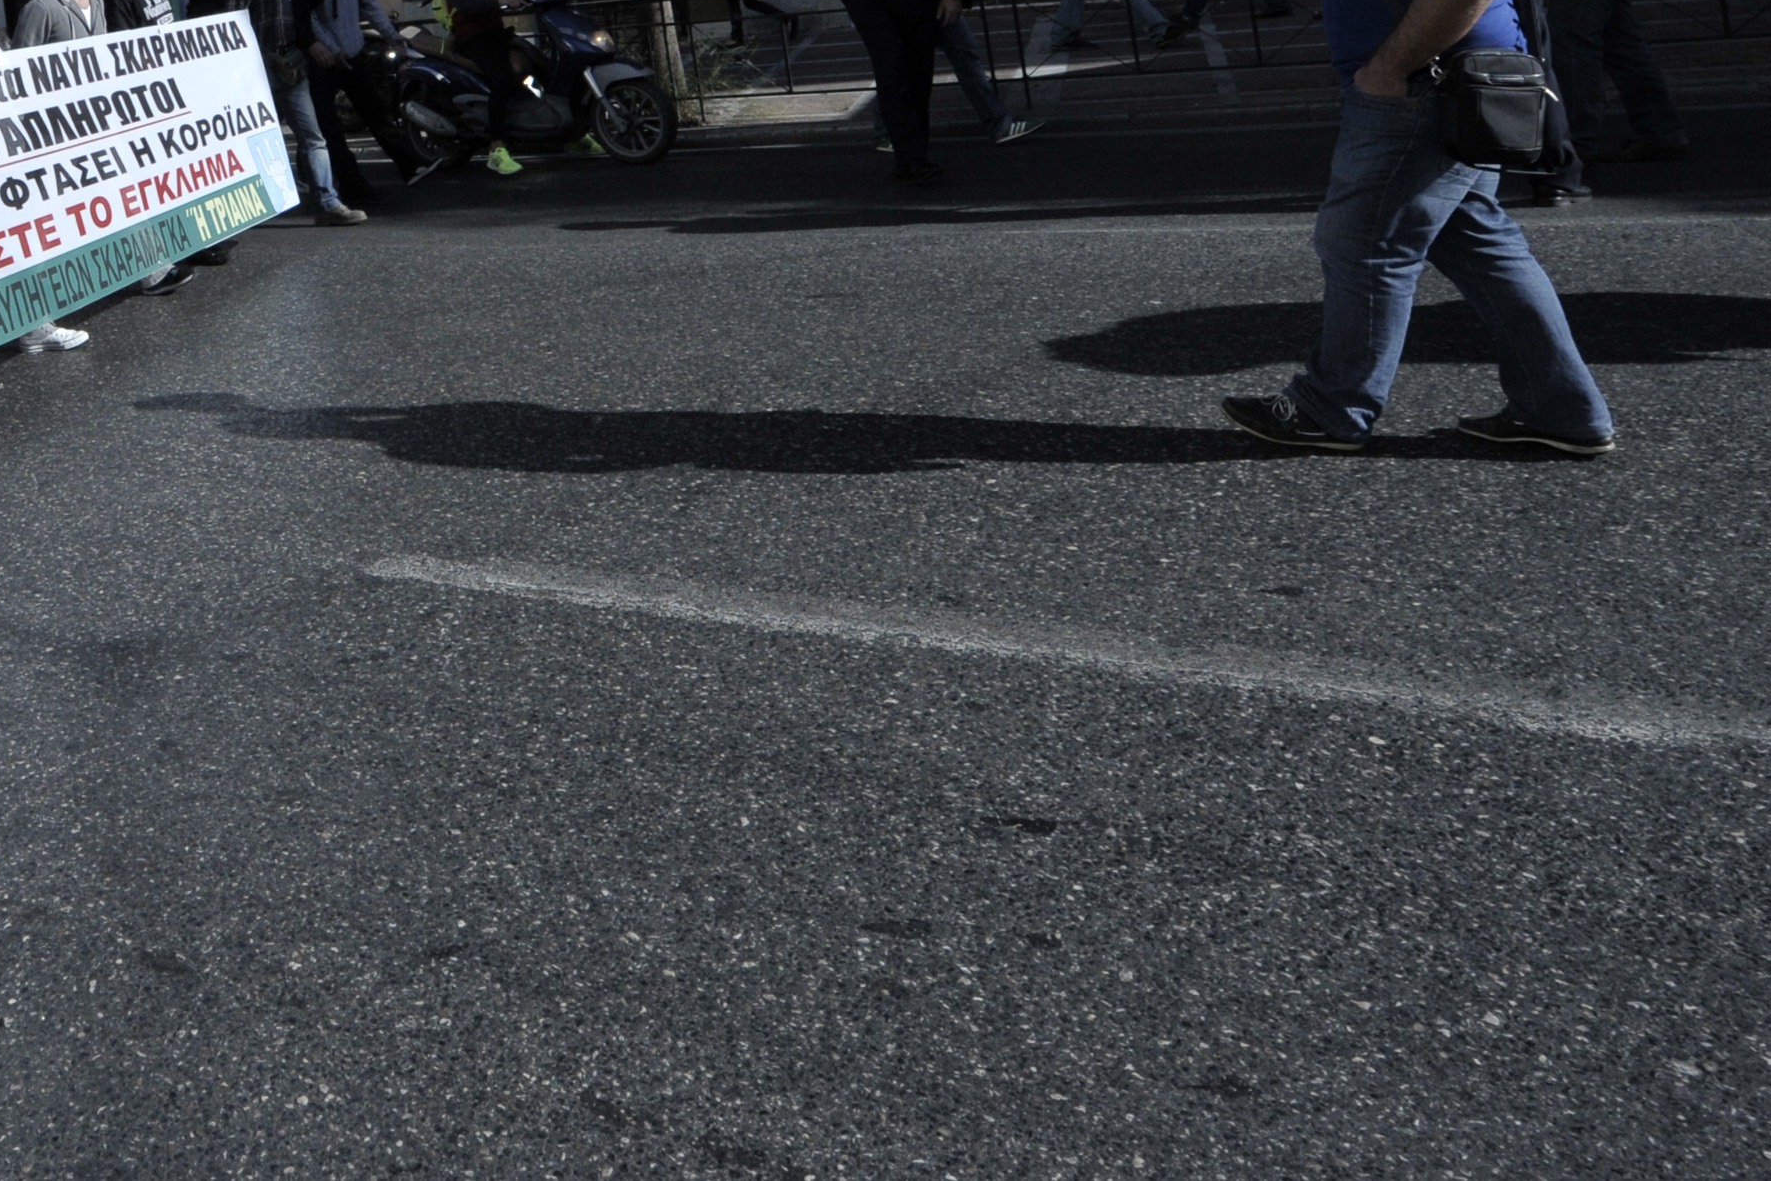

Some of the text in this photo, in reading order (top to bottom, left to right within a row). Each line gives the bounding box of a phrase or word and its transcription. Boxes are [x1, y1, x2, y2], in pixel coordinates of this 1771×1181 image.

[106, 20, 248, 77] ΣΚΑΡΑΜΑΓΚΑ
[0, 146, 127, 210] ΦΤΑΣΕΙ
[128, 137, 156, 168] Η
[157, 101, 276, 159] ΚΟΡΟΪΔΙΑ
[65, 195, 112, 237] ΤΟ
[119, 149, 245, 218] ΕΓΚΛΗΜΑ
[90, 214, 192, 291] ΣΚΑΡΑΜΑΓΚΑ
